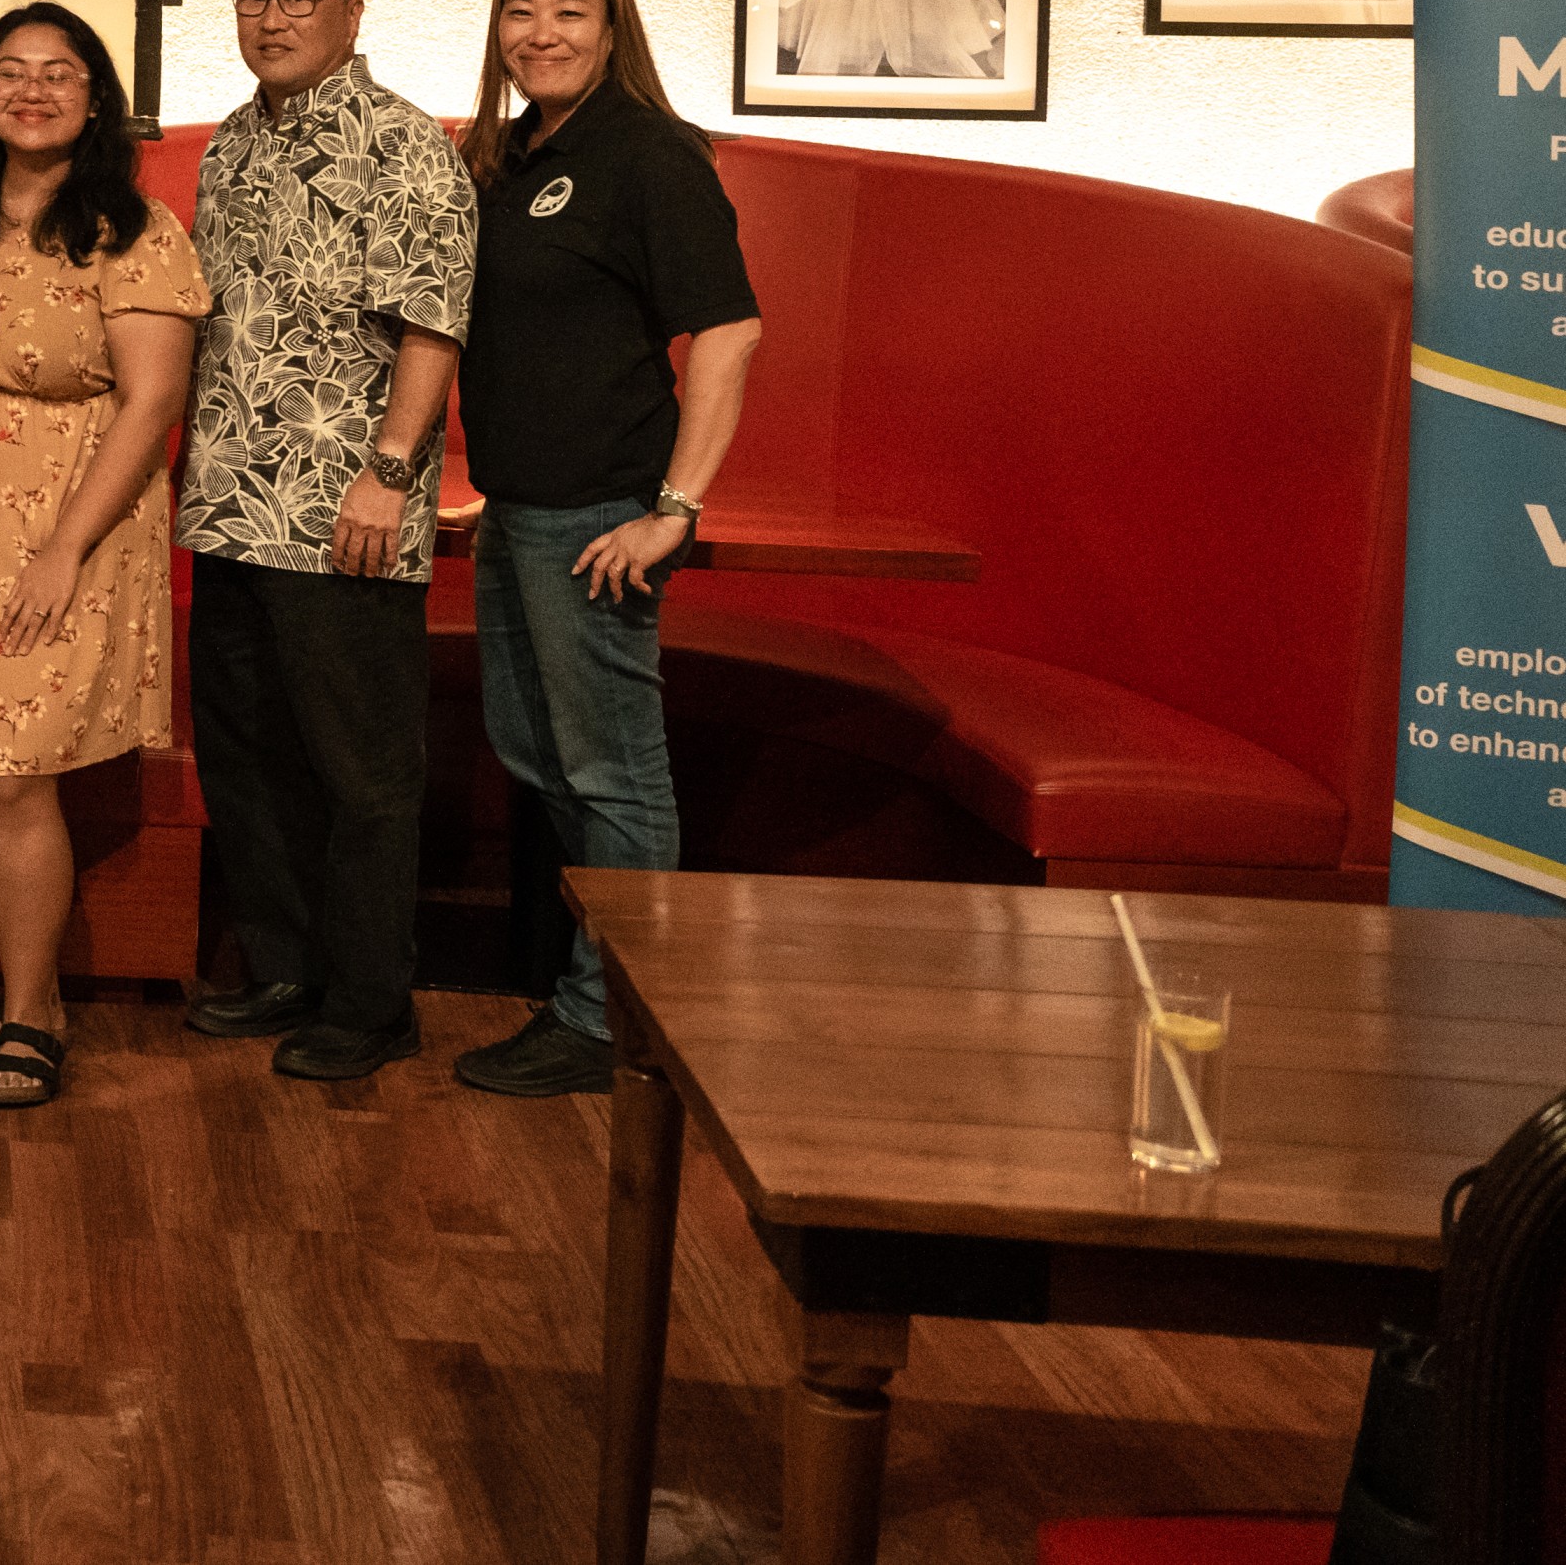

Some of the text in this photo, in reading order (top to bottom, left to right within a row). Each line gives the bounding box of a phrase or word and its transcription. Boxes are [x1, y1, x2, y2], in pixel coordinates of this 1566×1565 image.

[1472, 264, 1510, 290] to
[1455, 646, 1566, 678] emplo
[1415, 682, 1449, 707] of
[1407, 721, 1566, 763] to enhan
